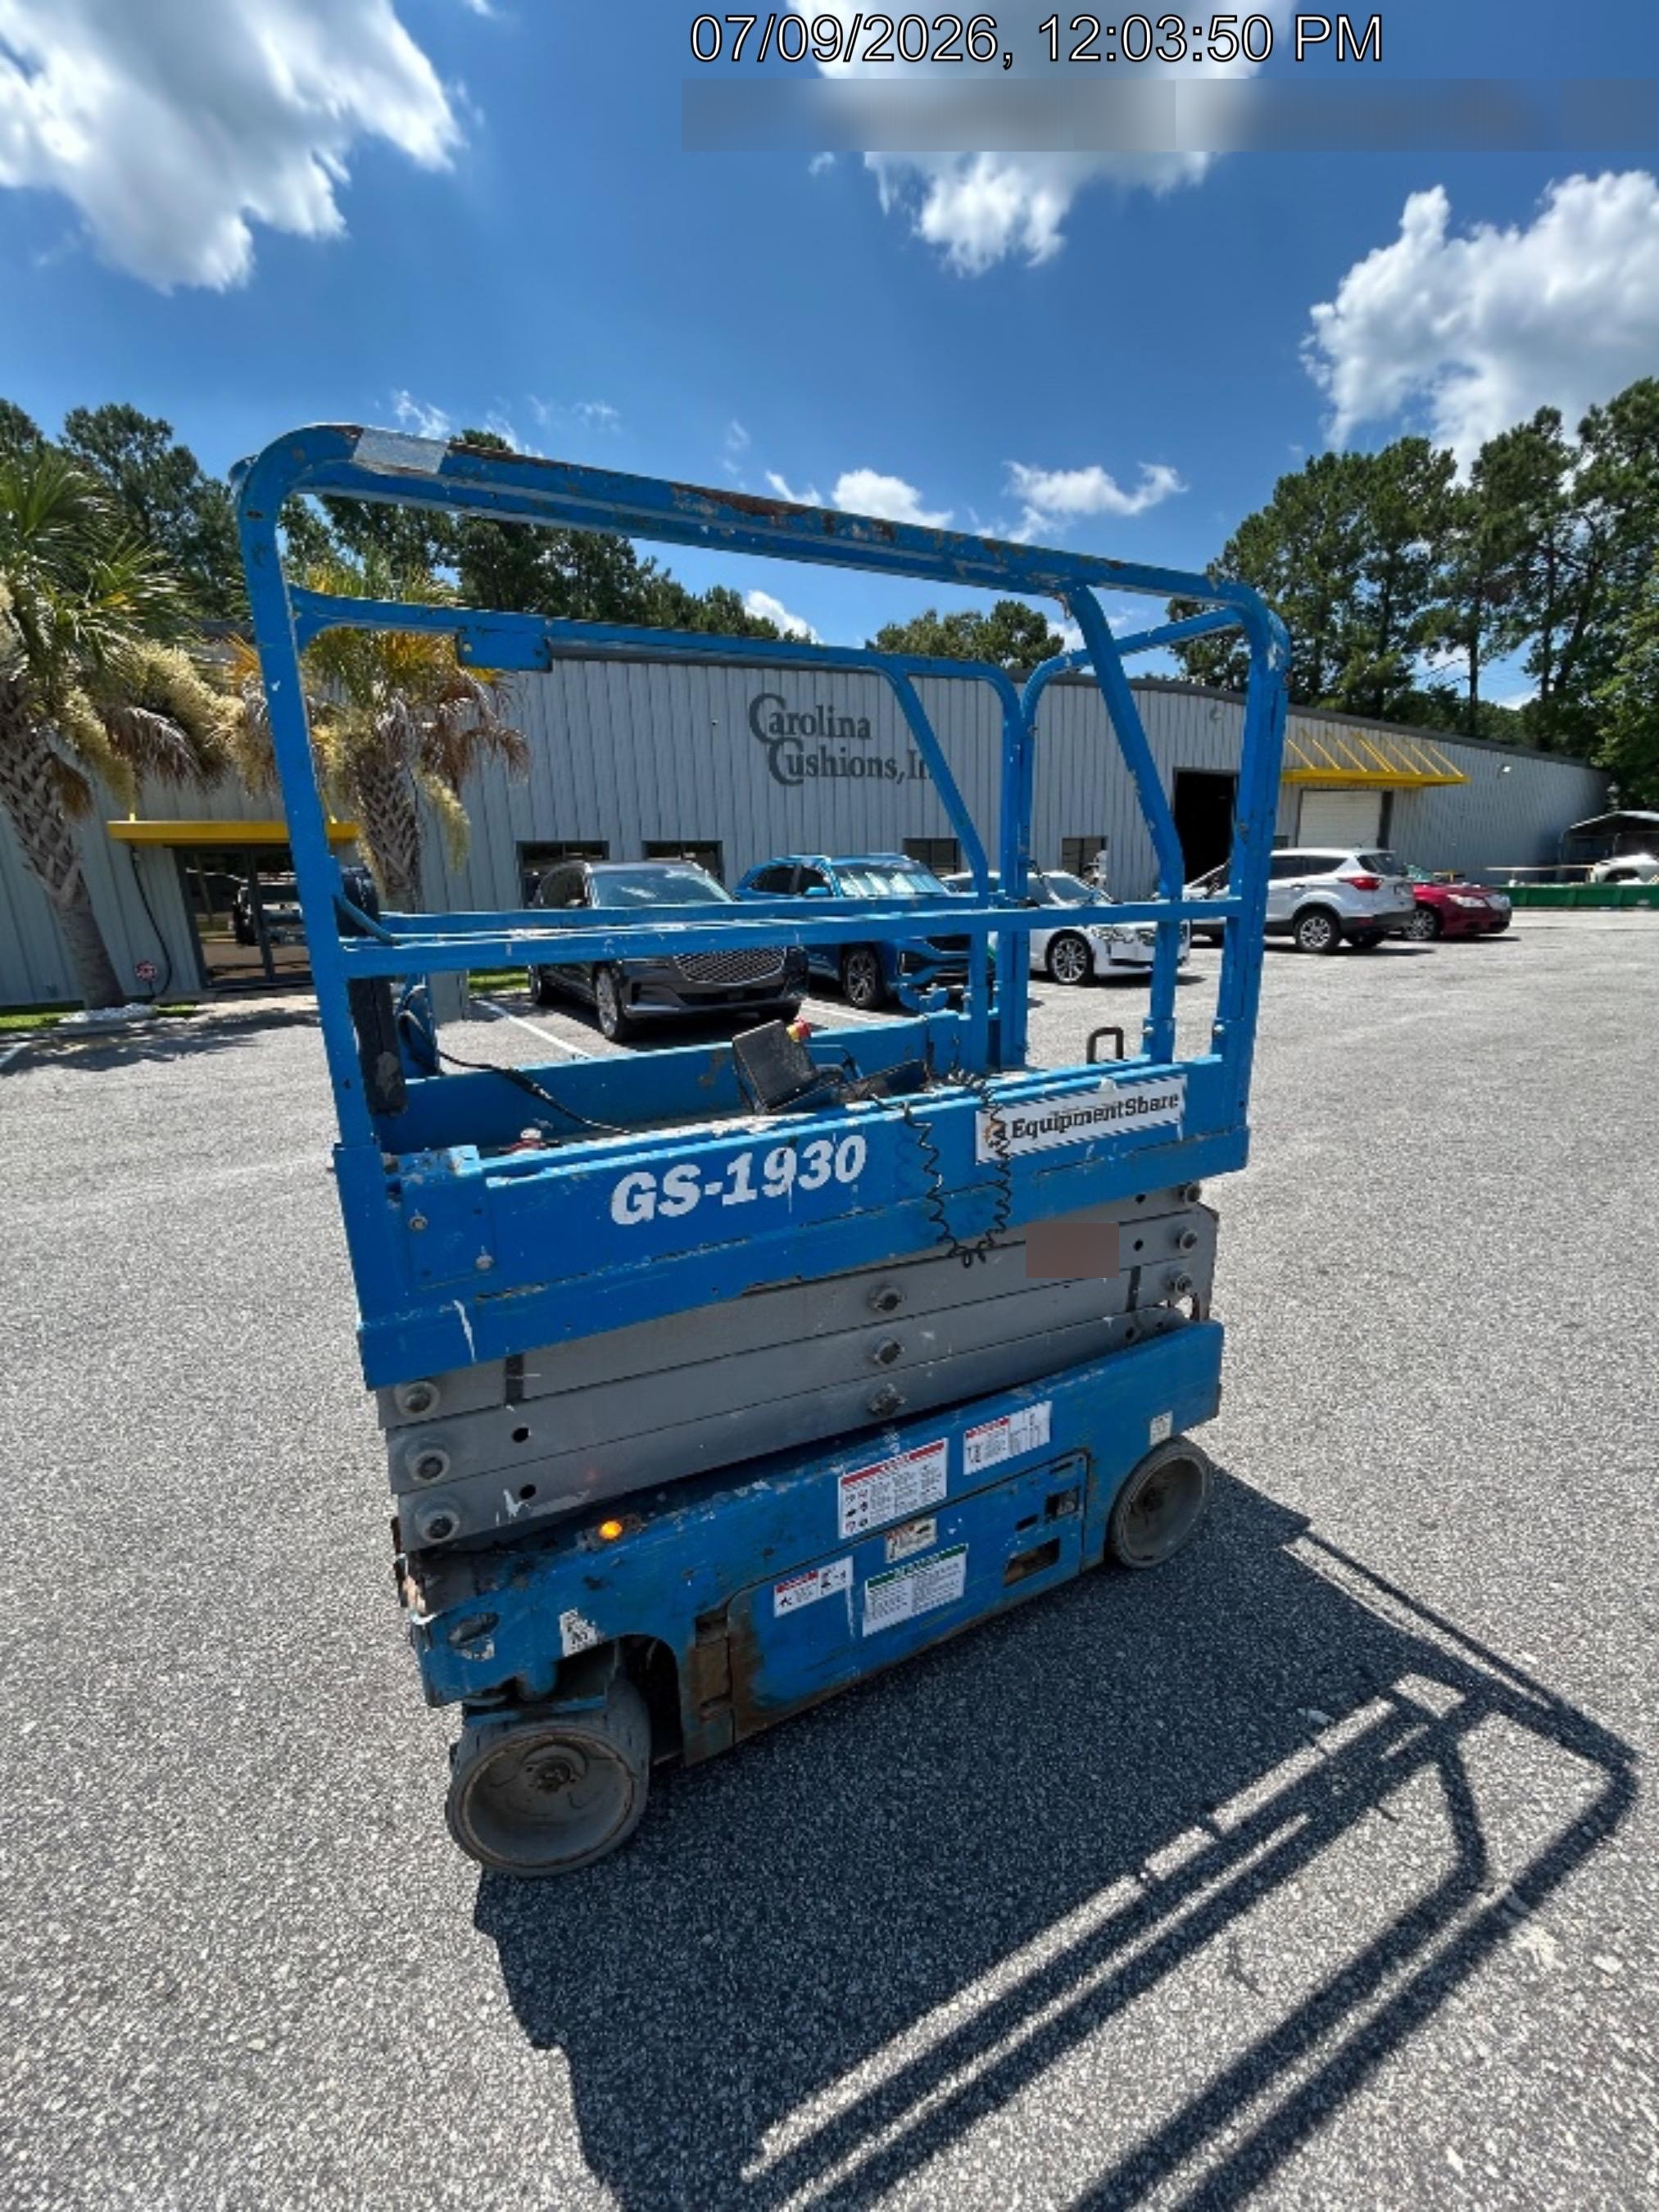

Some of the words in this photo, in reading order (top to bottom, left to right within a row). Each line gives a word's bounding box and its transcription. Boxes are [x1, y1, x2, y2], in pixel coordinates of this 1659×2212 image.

[749, 693, 872, 744] Carolina
[1011, 1093, 1179, 1139] EquipmentShare
[610, 1135, 867, 1225] GS-1930
